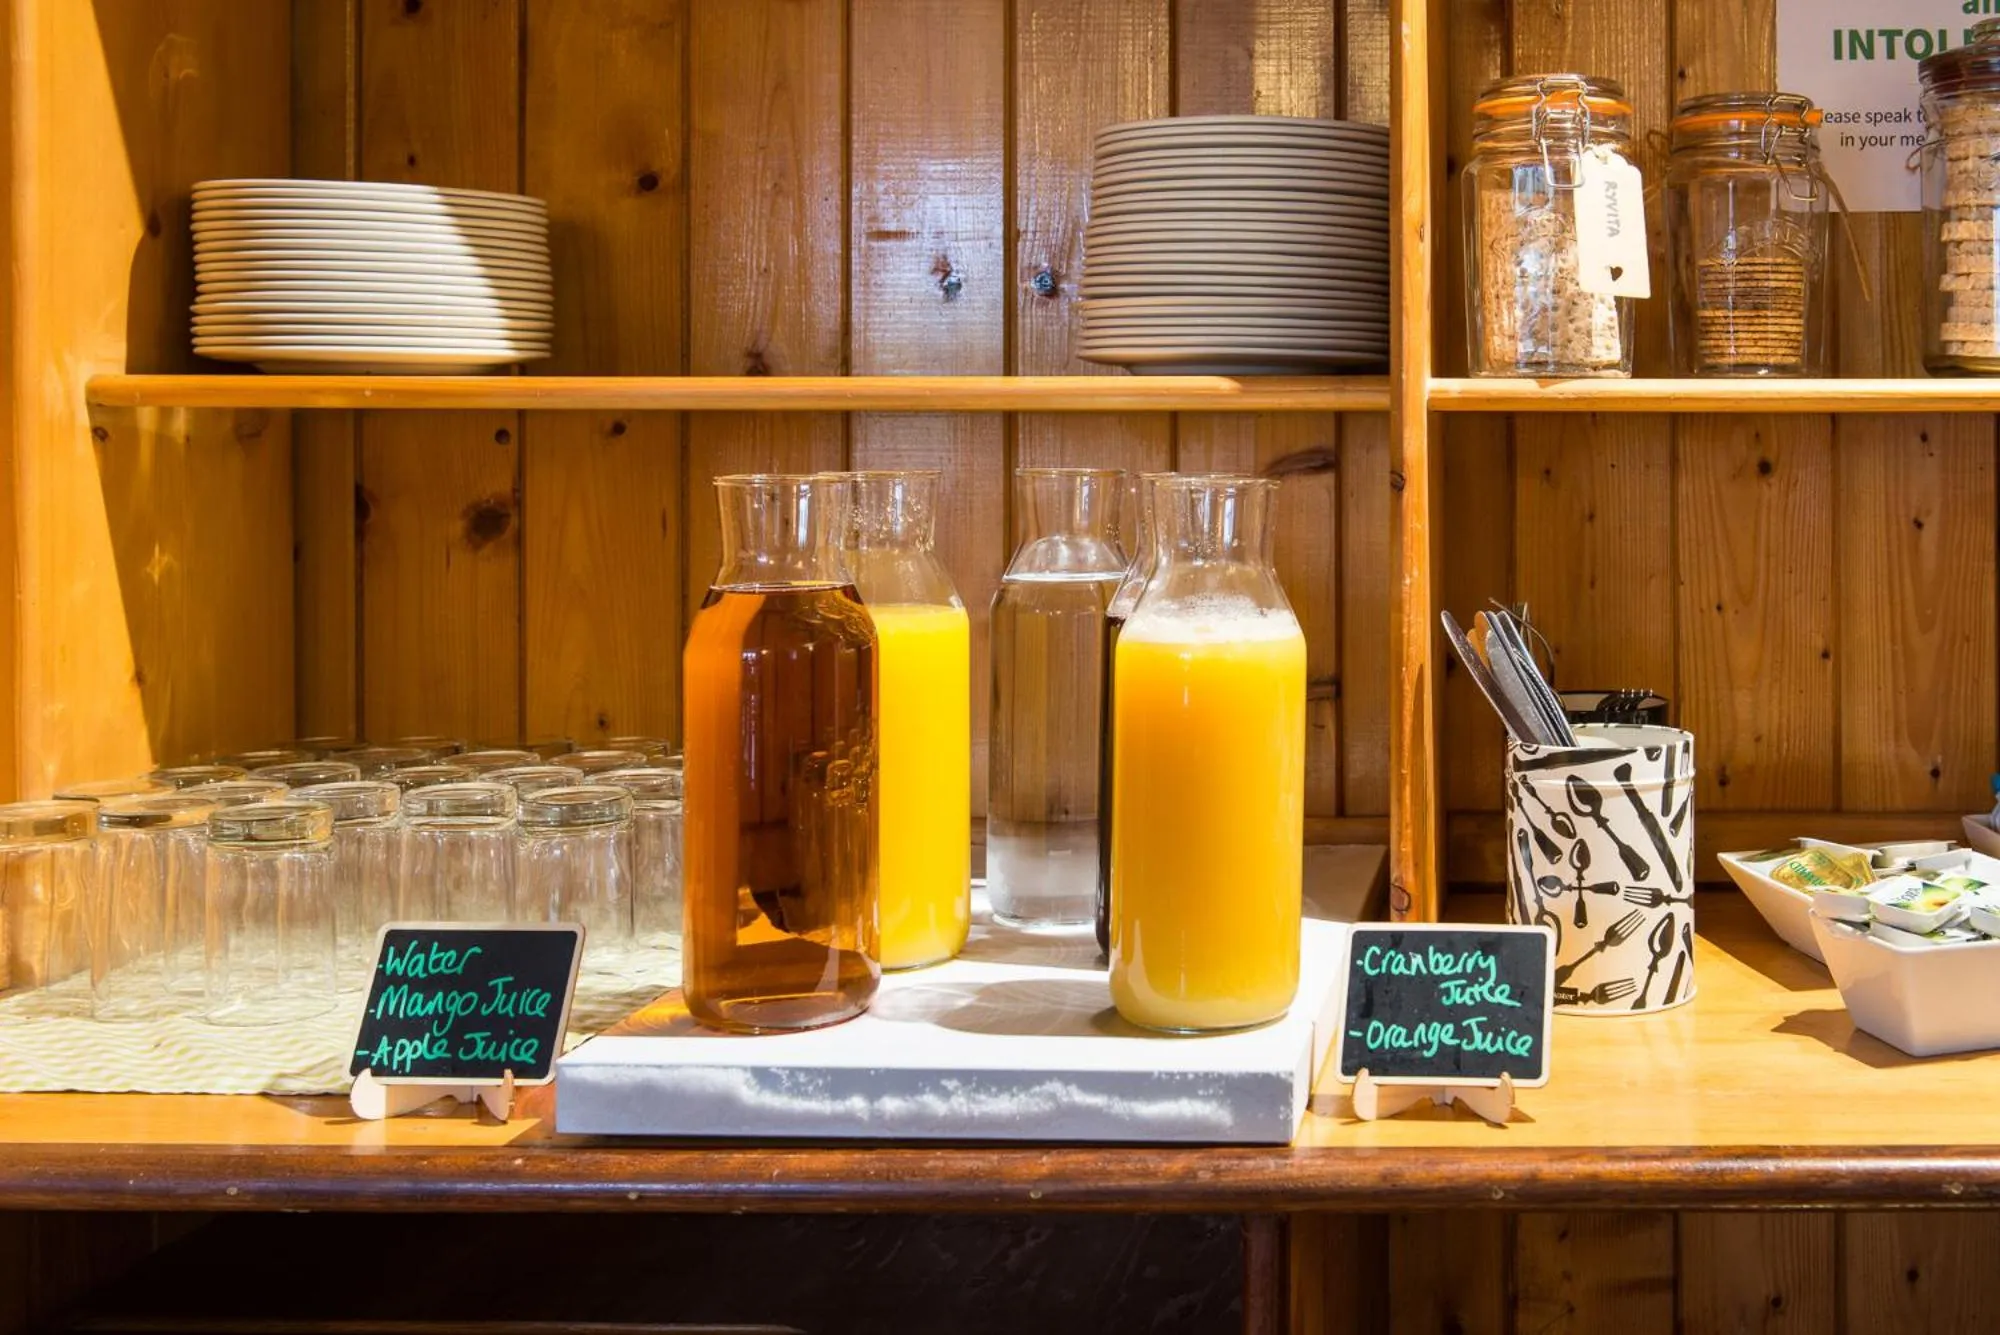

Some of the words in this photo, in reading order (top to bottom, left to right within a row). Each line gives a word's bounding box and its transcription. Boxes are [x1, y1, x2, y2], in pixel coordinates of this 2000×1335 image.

[1821, 111, 1861, 123] ease
[1865, 108, 1911, 127] speak
[1840, 132, 1854, 146] in
[1860, 135, 1896, 150] your
[1604, 180, 1620, 237] RYVITA
[481, 976, 552, 1018] Juice
[1439, 977, 1522, 1007] Juice
[458, 1028, 539, 1064] Juice
[1462, 1016, 1533, 1056] Juice
